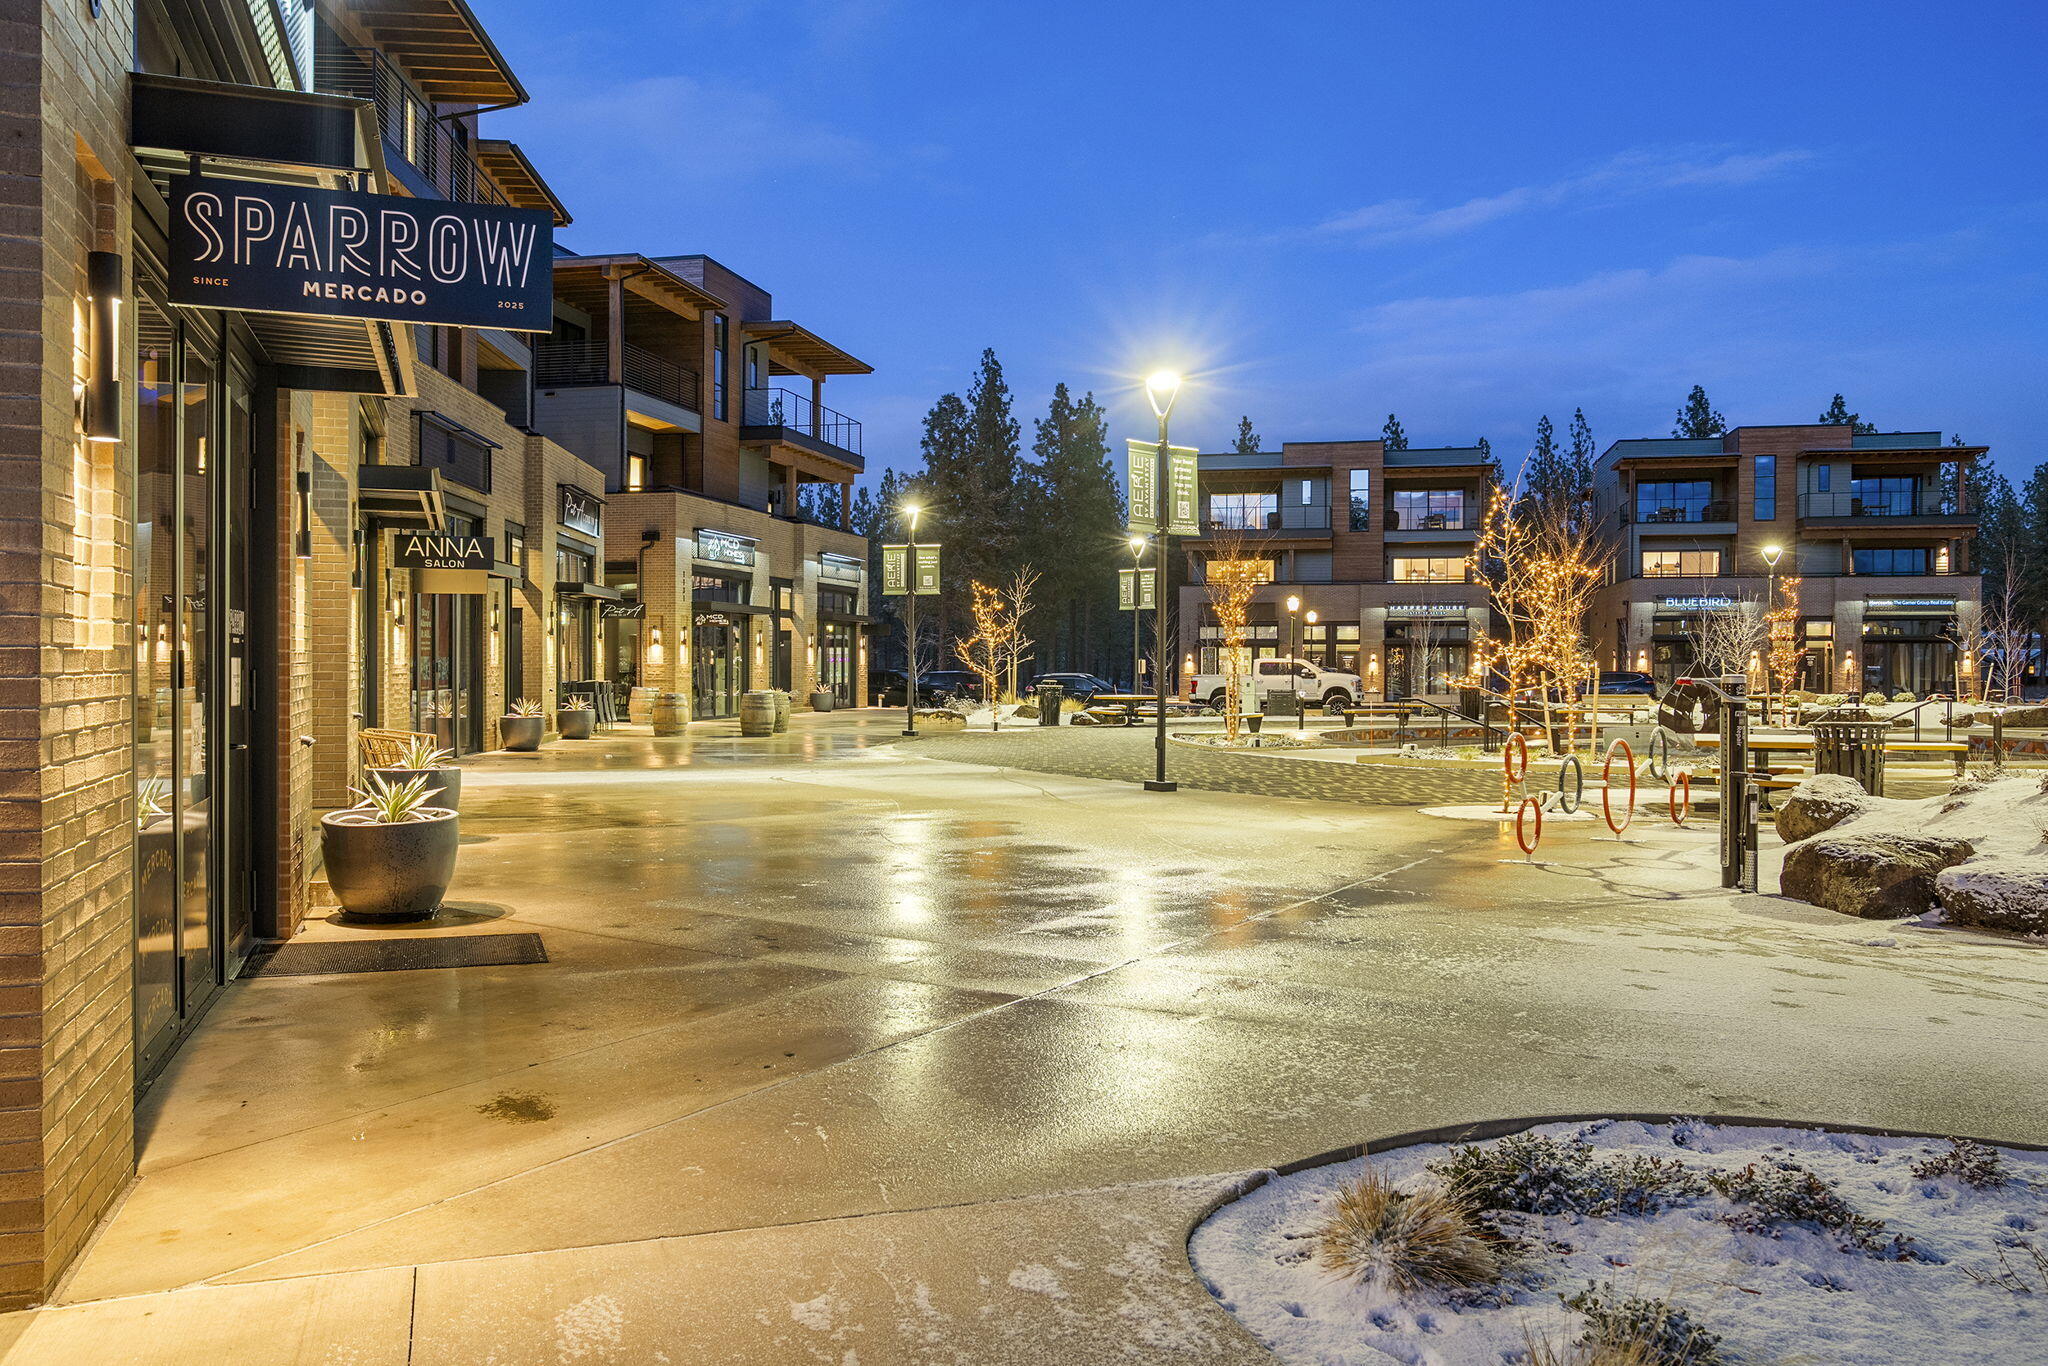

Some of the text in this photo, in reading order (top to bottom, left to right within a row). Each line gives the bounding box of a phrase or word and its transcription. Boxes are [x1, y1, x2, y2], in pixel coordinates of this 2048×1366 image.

[184, 192, 536, 288] SPARROW
[193, 276, 230, 287] SINCE
[302, 281, 427, 306] MERCADO
[498, 301, 525, 310] 2025
[1131, 455, 1144, 517] AERIE
[405, 537, 484, 558] ANNA
[720, 538, 740, 549] MCD
[424, 559, 465, 568] SALON
[1666, 597, 1731, 607] BLUEBIRD
[141, 849, 173, 894] MERCADO
